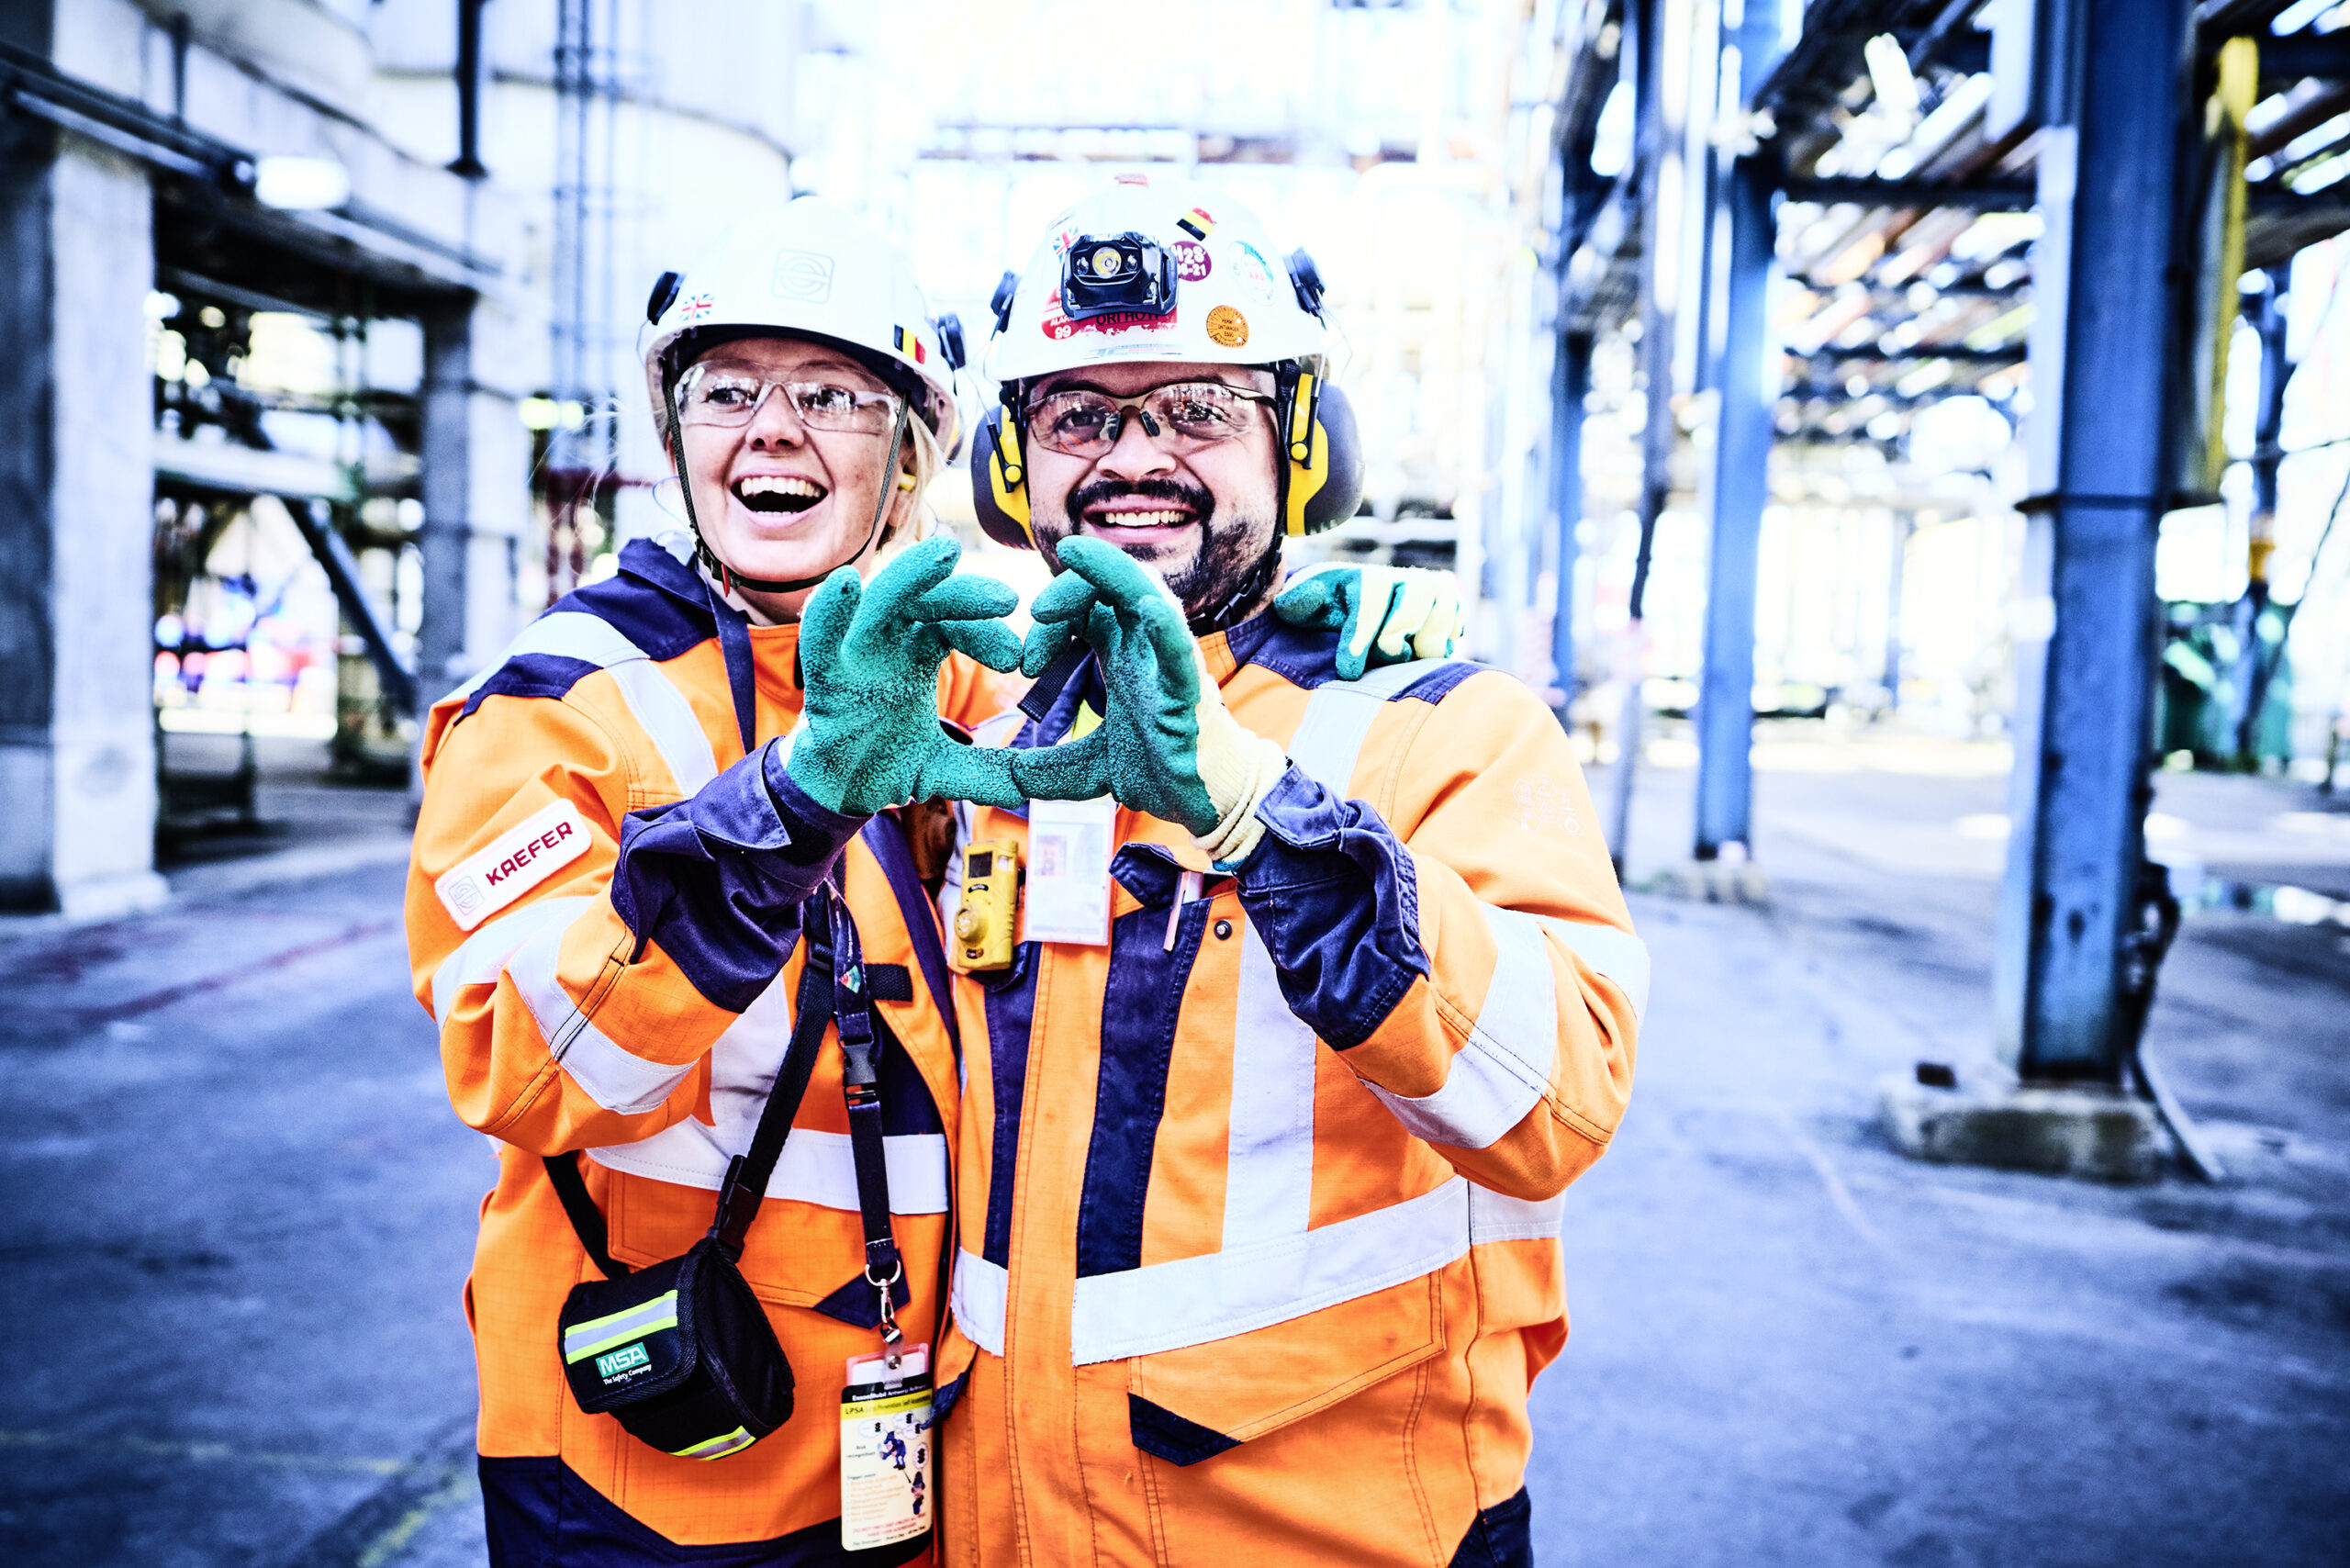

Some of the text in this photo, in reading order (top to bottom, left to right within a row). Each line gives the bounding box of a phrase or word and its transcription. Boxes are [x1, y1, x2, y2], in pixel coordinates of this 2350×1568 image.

[1055, 325, 1071, 340] 99
[485, 821, 574, 886] KAEFER
[599, 1346, 647, 1375] MSA
